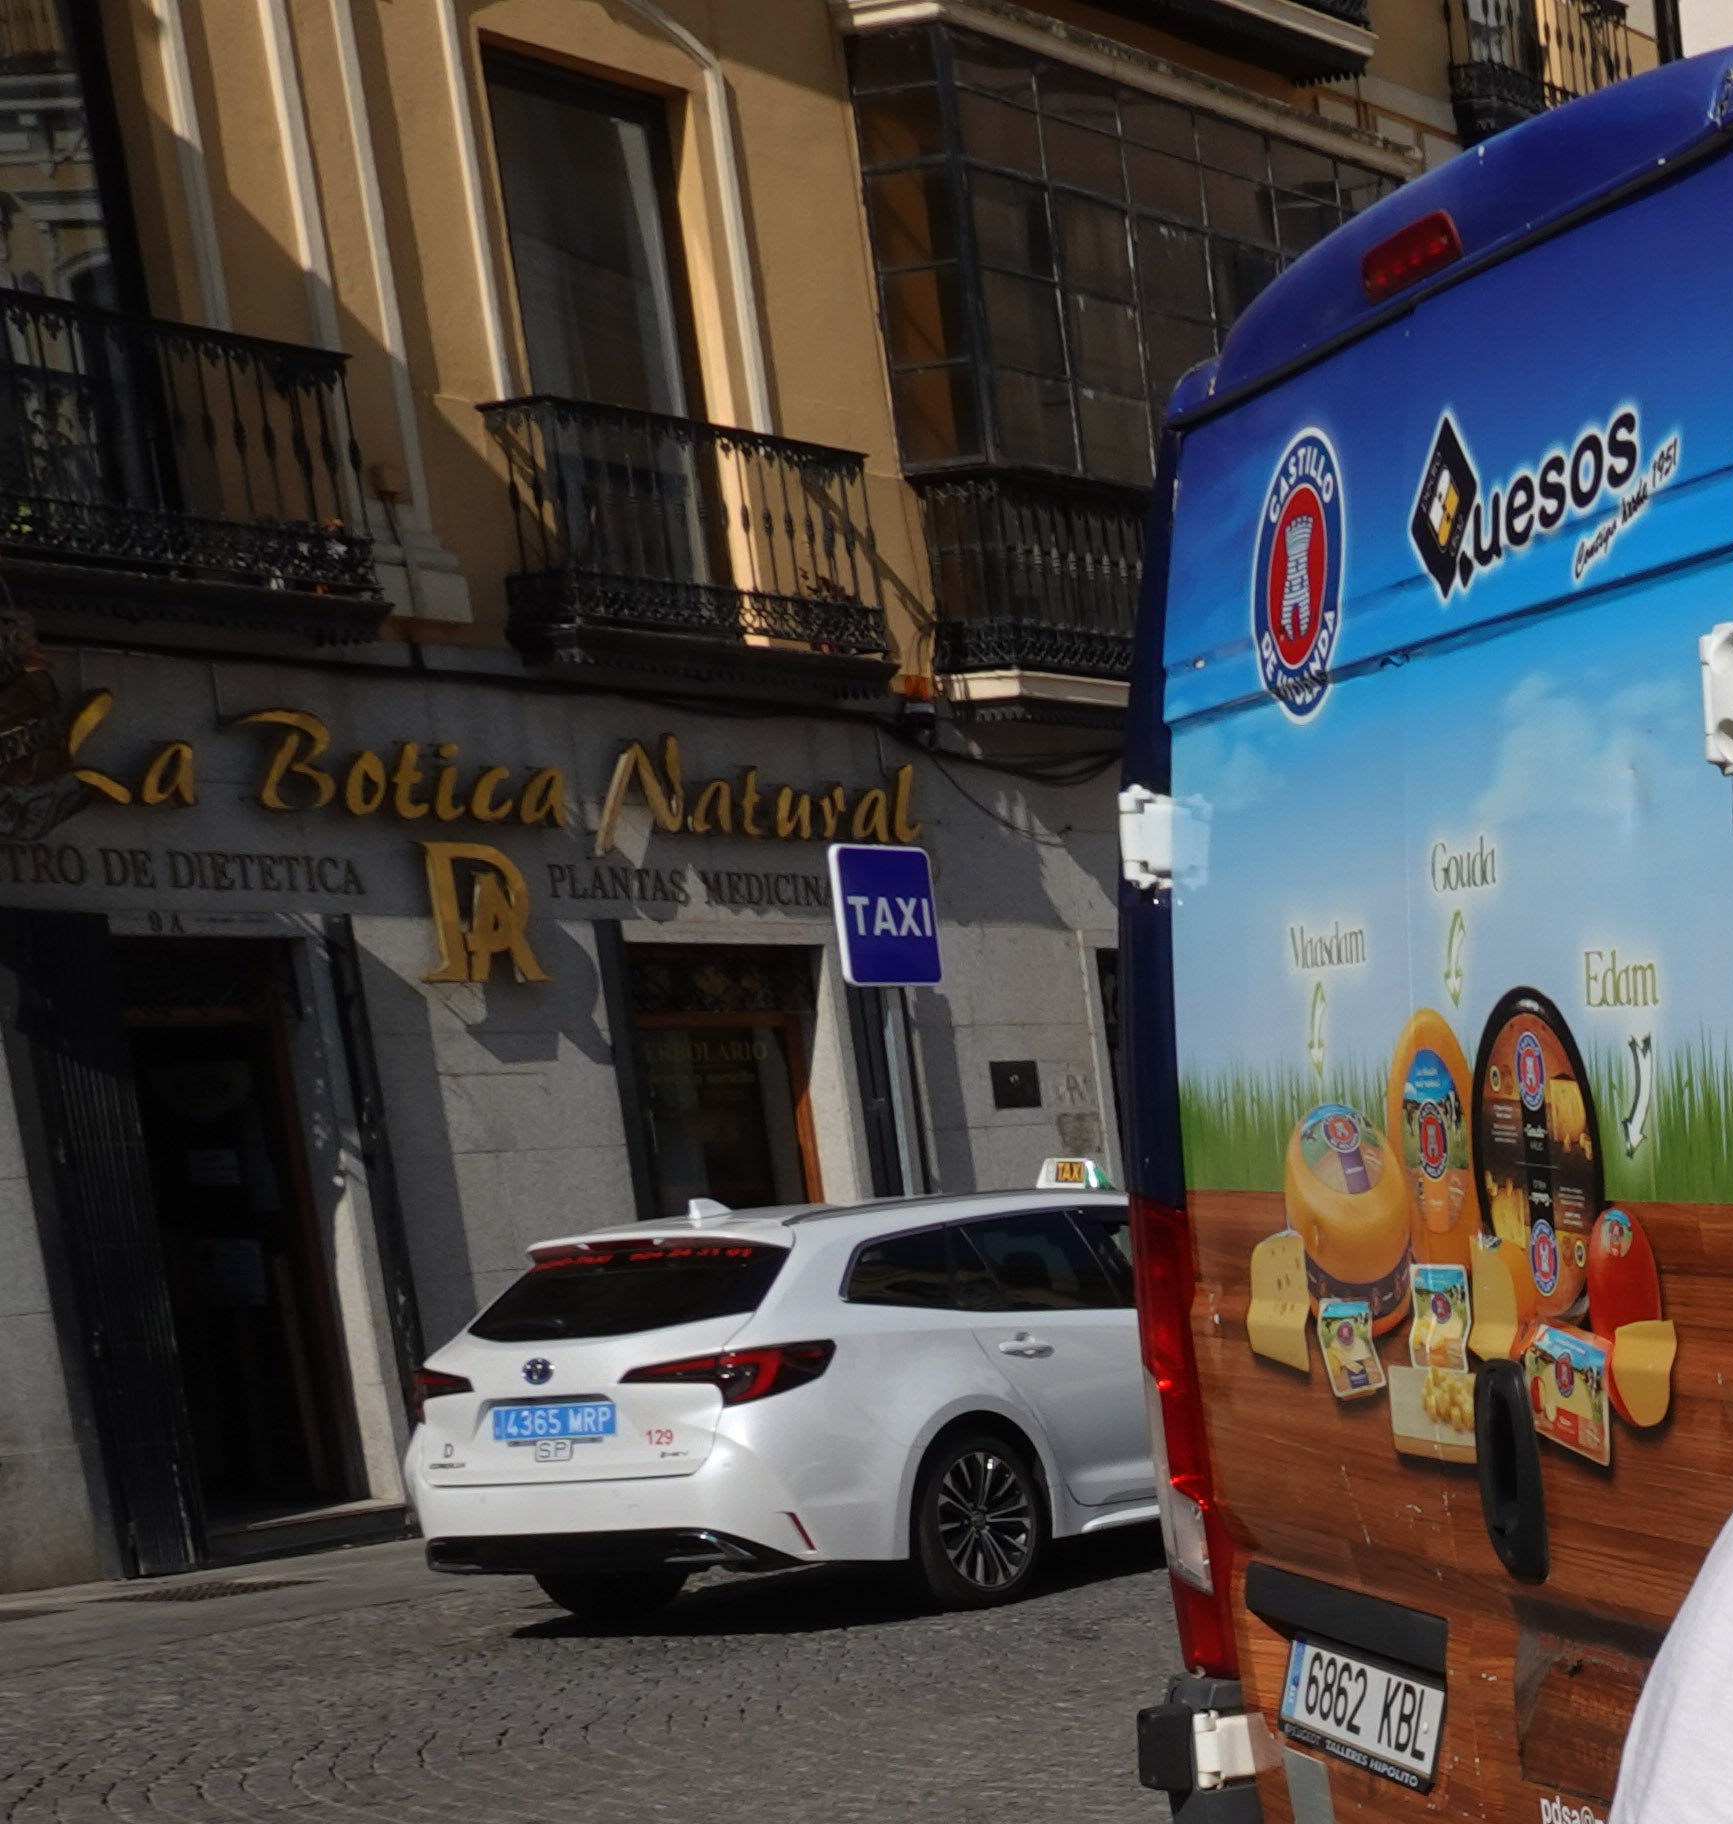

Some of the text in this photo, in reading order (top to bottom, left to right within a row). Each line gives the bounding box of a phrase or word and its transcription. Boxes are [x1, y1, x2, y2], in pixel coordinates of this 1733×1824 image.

[1268, 445, 1334, 524] CASTILLO
[1651, 436, 1679, 490] 1951
[1260, 629, 1279, 682] DE
[68, 686, 925, 856] La Botica Natural
[98, 848, 157, 890] DE
[167, 850, 367, 896] DIETETICA
[546, 863, 689, 904] PLANTAS
[1431, 835, 1497, 893] Gouda
[847, 894, 934, 939] TAXI
[1584, 949, 1660, 1008] Edam
[1057, 1161, 1085, 1183] TAXI
[506, 1406, 612, 1437] 4365 MRP
[645, 1429, 674, 1446] 129
[538, 1441, 567, 1459] SP
[1304, 1650, 1426, 1762] 6862 KBL
[1325, 1738, 1369, 1767] TALLERES
[1368, 1758, 1419, 1788] HIPOLITO
